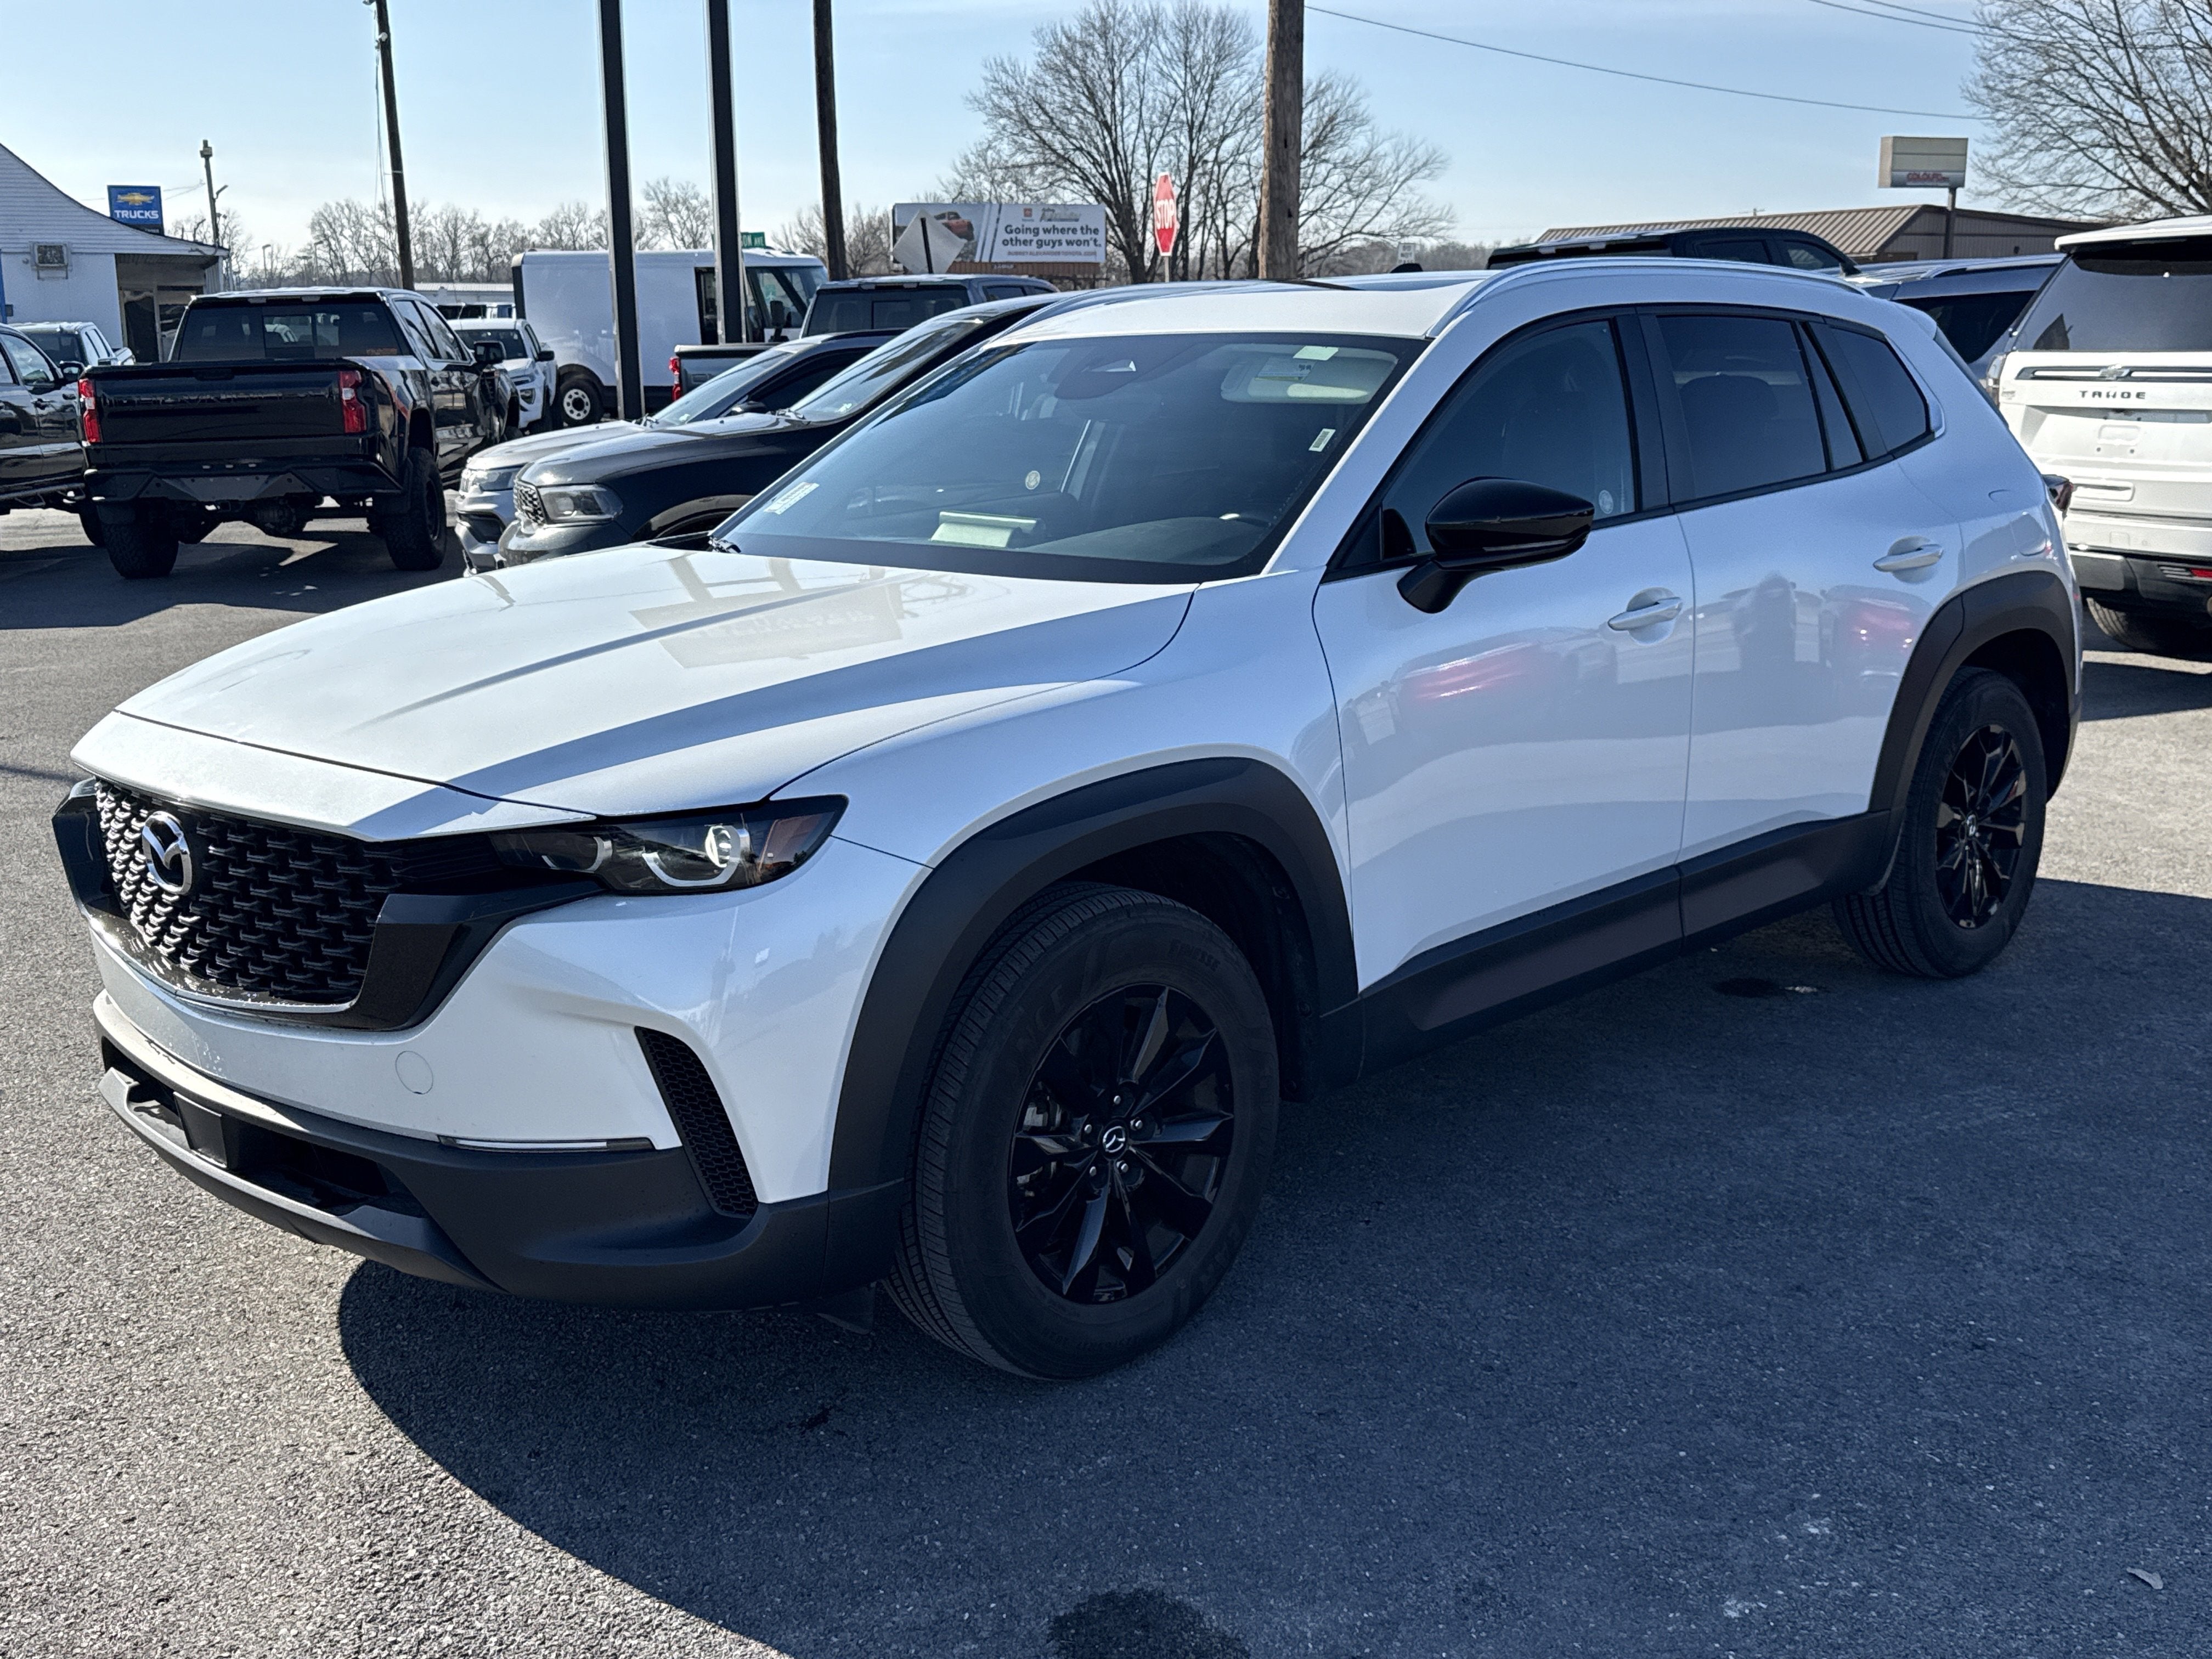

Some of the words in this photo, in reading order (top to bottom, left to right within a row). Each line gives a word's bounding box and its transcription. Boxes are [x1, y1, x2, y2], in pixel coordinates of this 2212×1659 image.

[114, 210, 159, 219] TRUCKS
[1156, 199, 1174, 229] STOP
[1005, 224, 1040, 237] Going
[1042, 224, 1077, 235] where
[1080, 224, 1099, 235] the
[1002, 236, 1034, 246] other
[1036, 238, 1063, 249] guys
[1065, 237, 1102, 247] won't.
[2079, 391, 2146, 400] TAHOE
